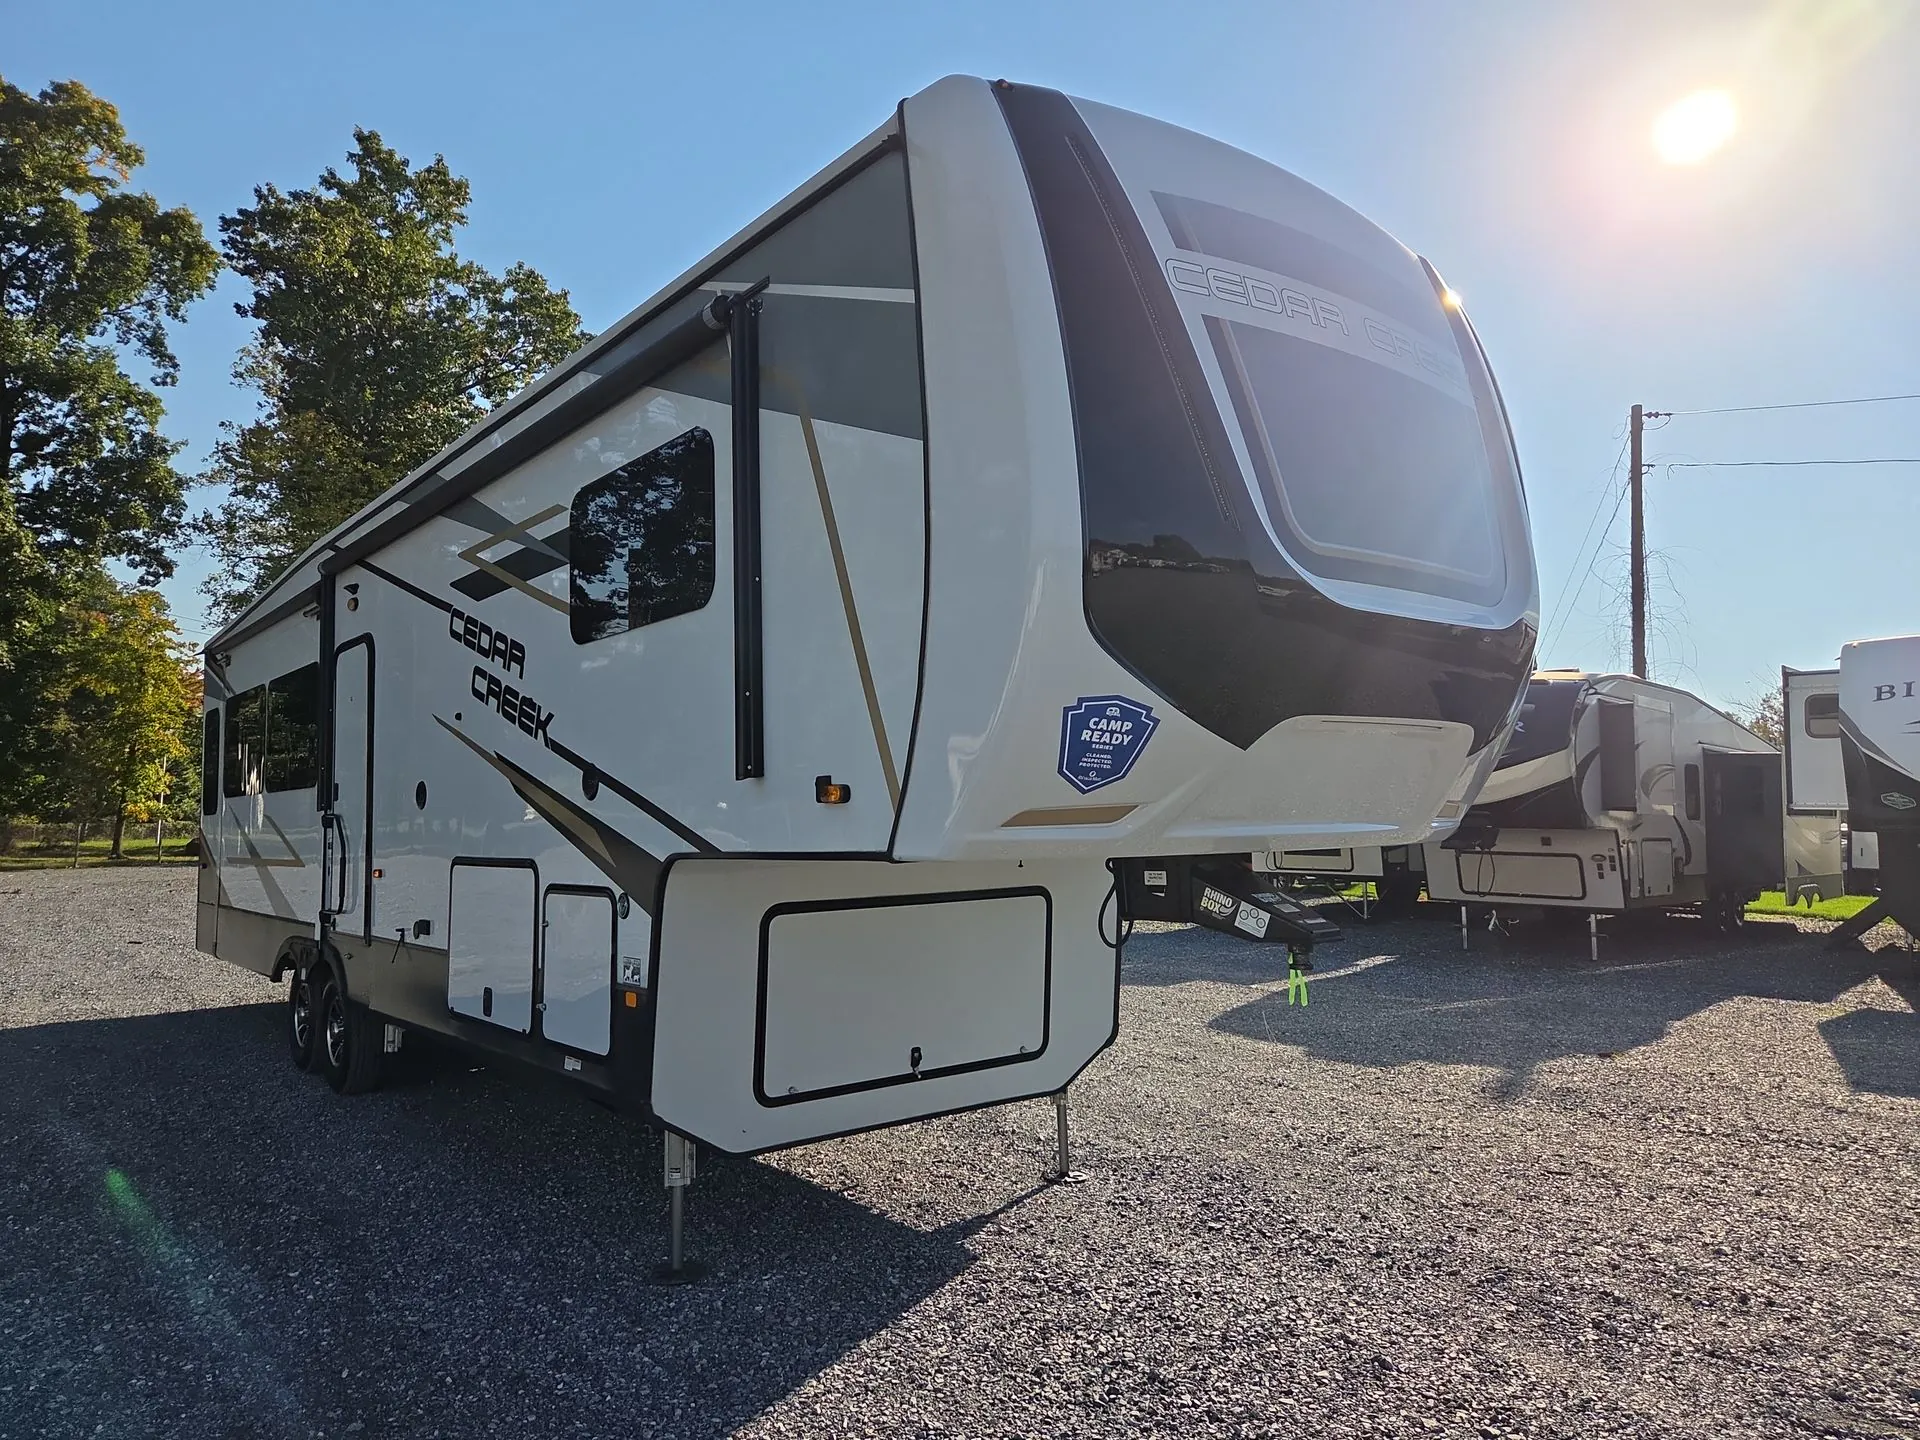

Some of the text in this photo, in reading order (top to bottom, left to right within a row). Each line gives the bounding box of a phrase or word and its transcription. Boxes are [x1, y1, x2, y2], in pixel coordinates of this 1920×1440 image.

[1164, 258, 1350, 336] CEDAR
[449, 607, 526, 680] CEDAR
[1872, 681, 1916, 702] BI
[471, 665, 555, 750] CREEK
[1089, 717, 1133, 733] CAMP
[1080, 729, 1133, 745] READY
[1091, 743, 1114, 751] SERIES
[1200, 896, 1221, 914] BOX
[1204, 887, 1233, 908] RHINO
